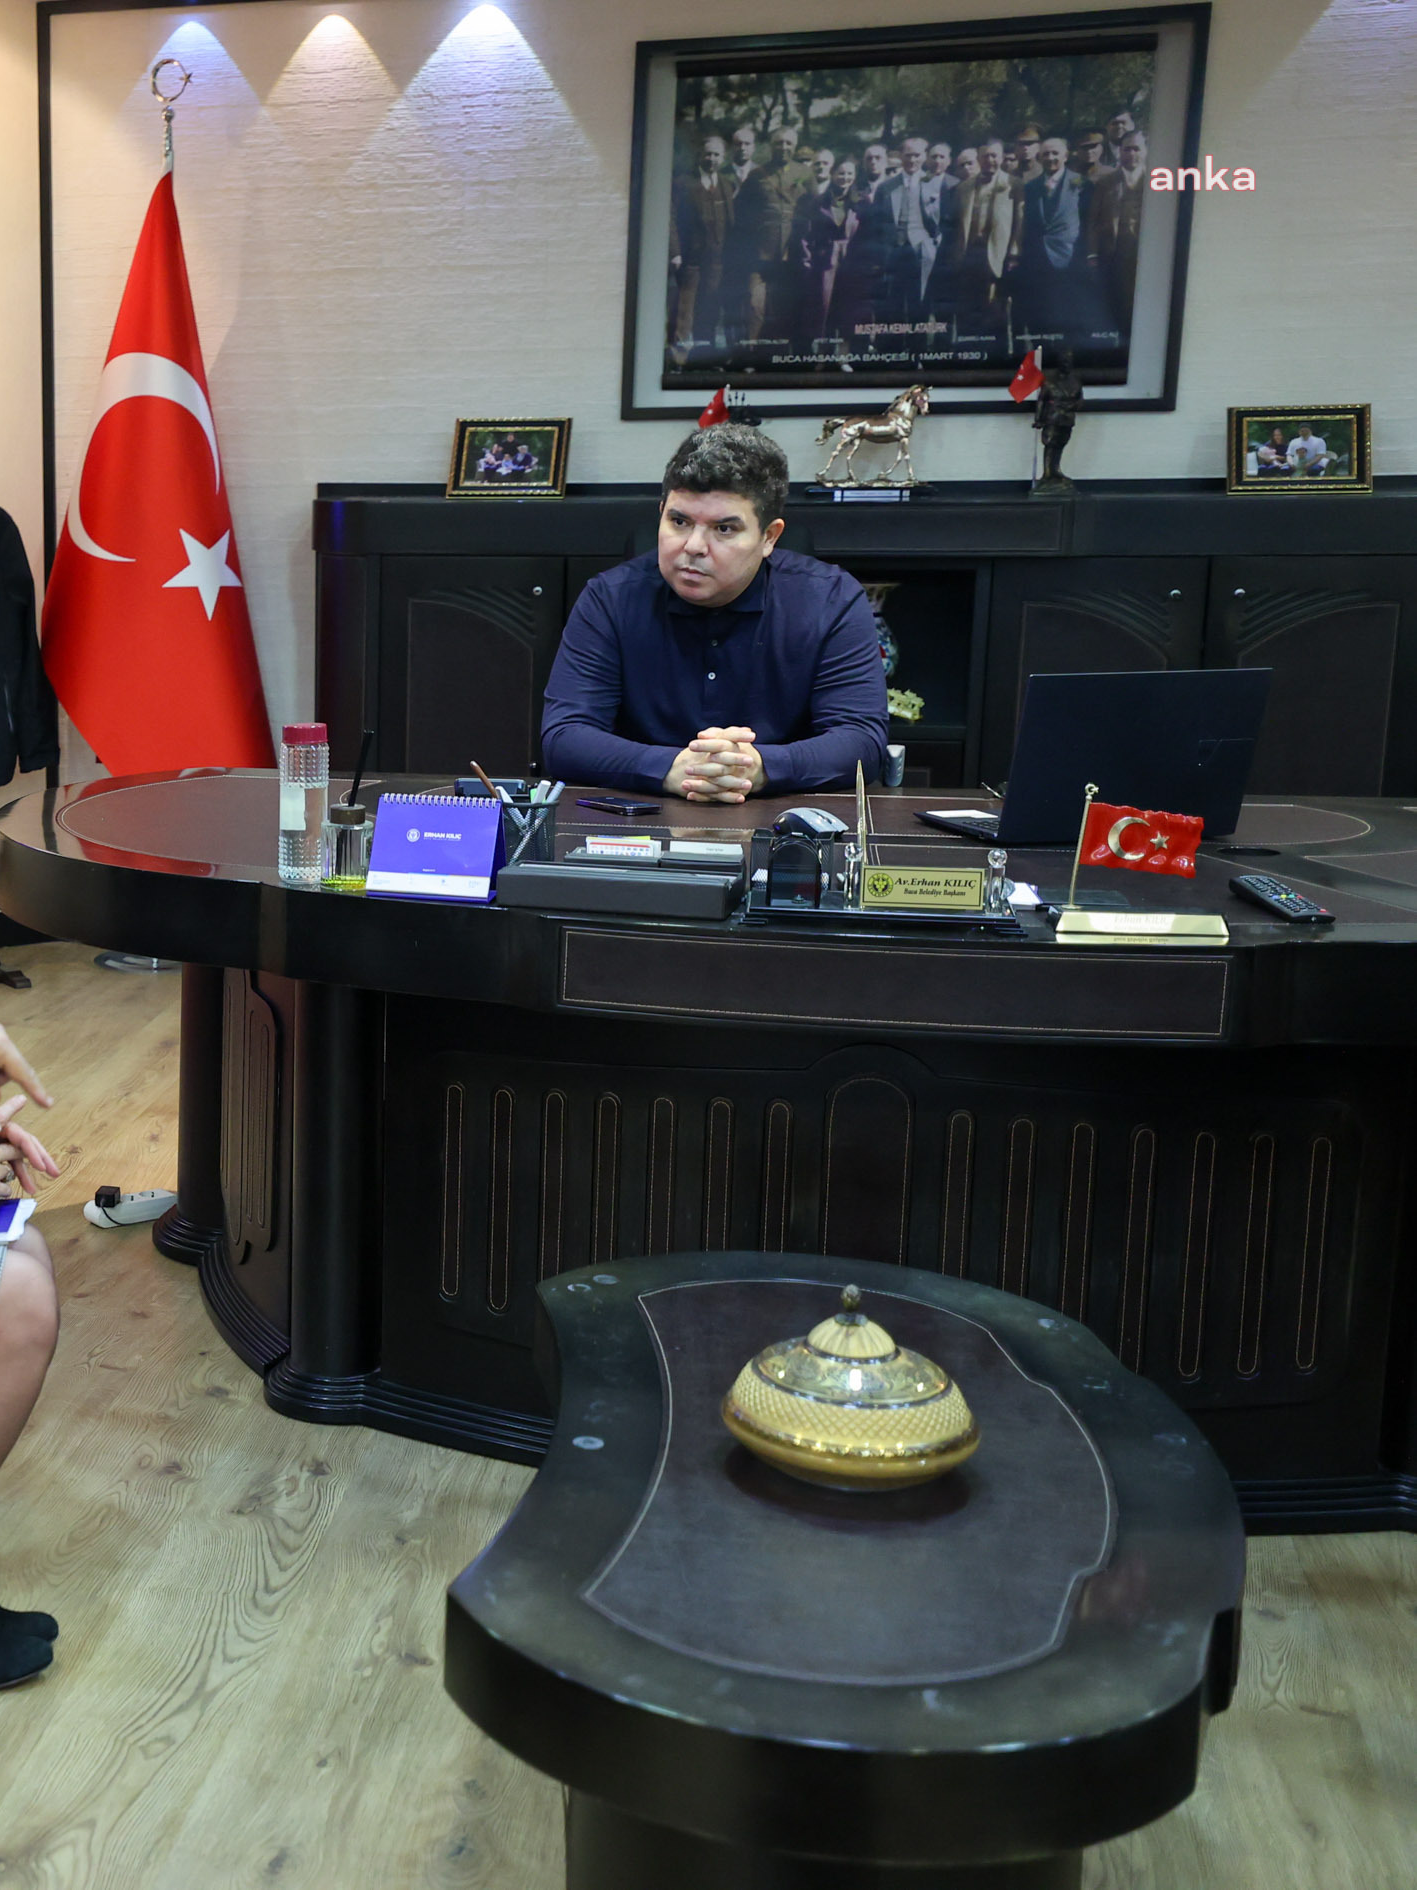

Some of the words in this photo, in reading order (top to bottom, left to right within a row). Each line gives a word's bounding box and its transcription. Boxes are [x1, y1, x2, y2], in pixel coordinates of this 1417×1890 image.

[772, 355, 801, 363] BUCA
[894, 877, 941, 887] Av.Erhan
[943, 879, 977, 889] KILIÇ
